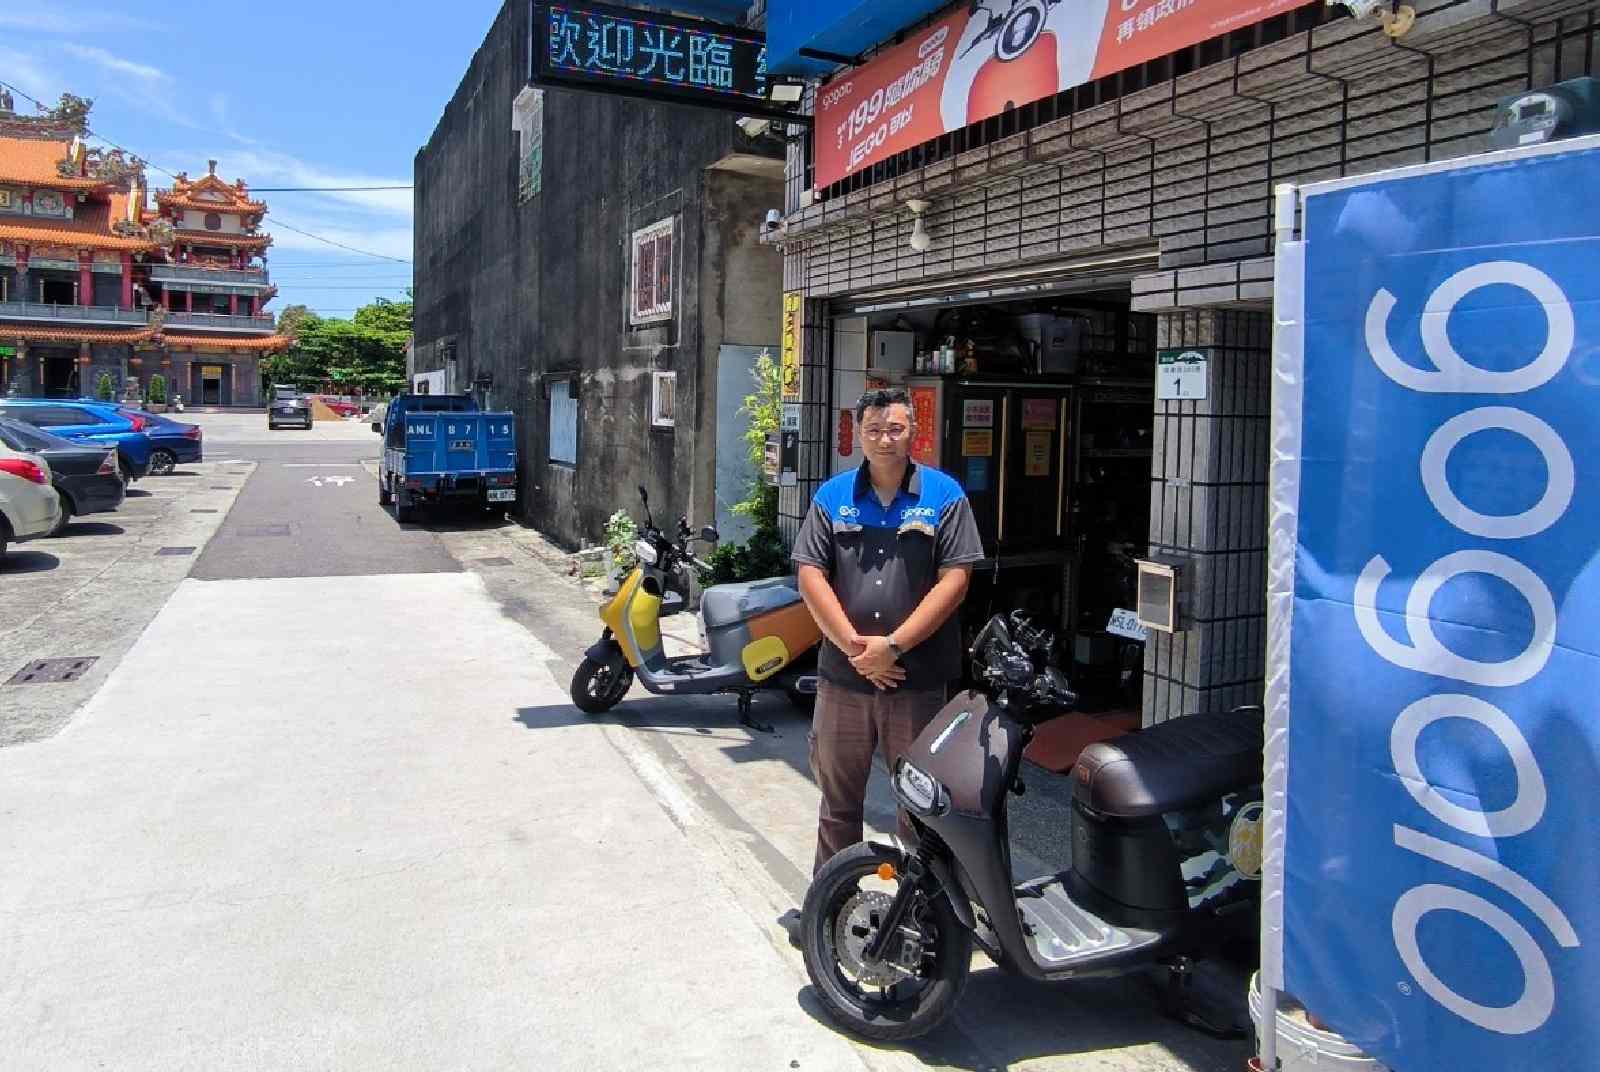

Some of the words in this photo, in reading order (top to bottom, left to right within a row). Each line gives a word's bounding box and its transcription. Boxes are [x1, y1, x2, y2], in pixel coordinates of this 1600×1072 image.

[551, 13, 734, 88] 歡迎光臨
[1173, 378, 1181, 396] 1
[407, 424, 433, 435] ANL
[1353, 259, 1582, 1036] gogoro
